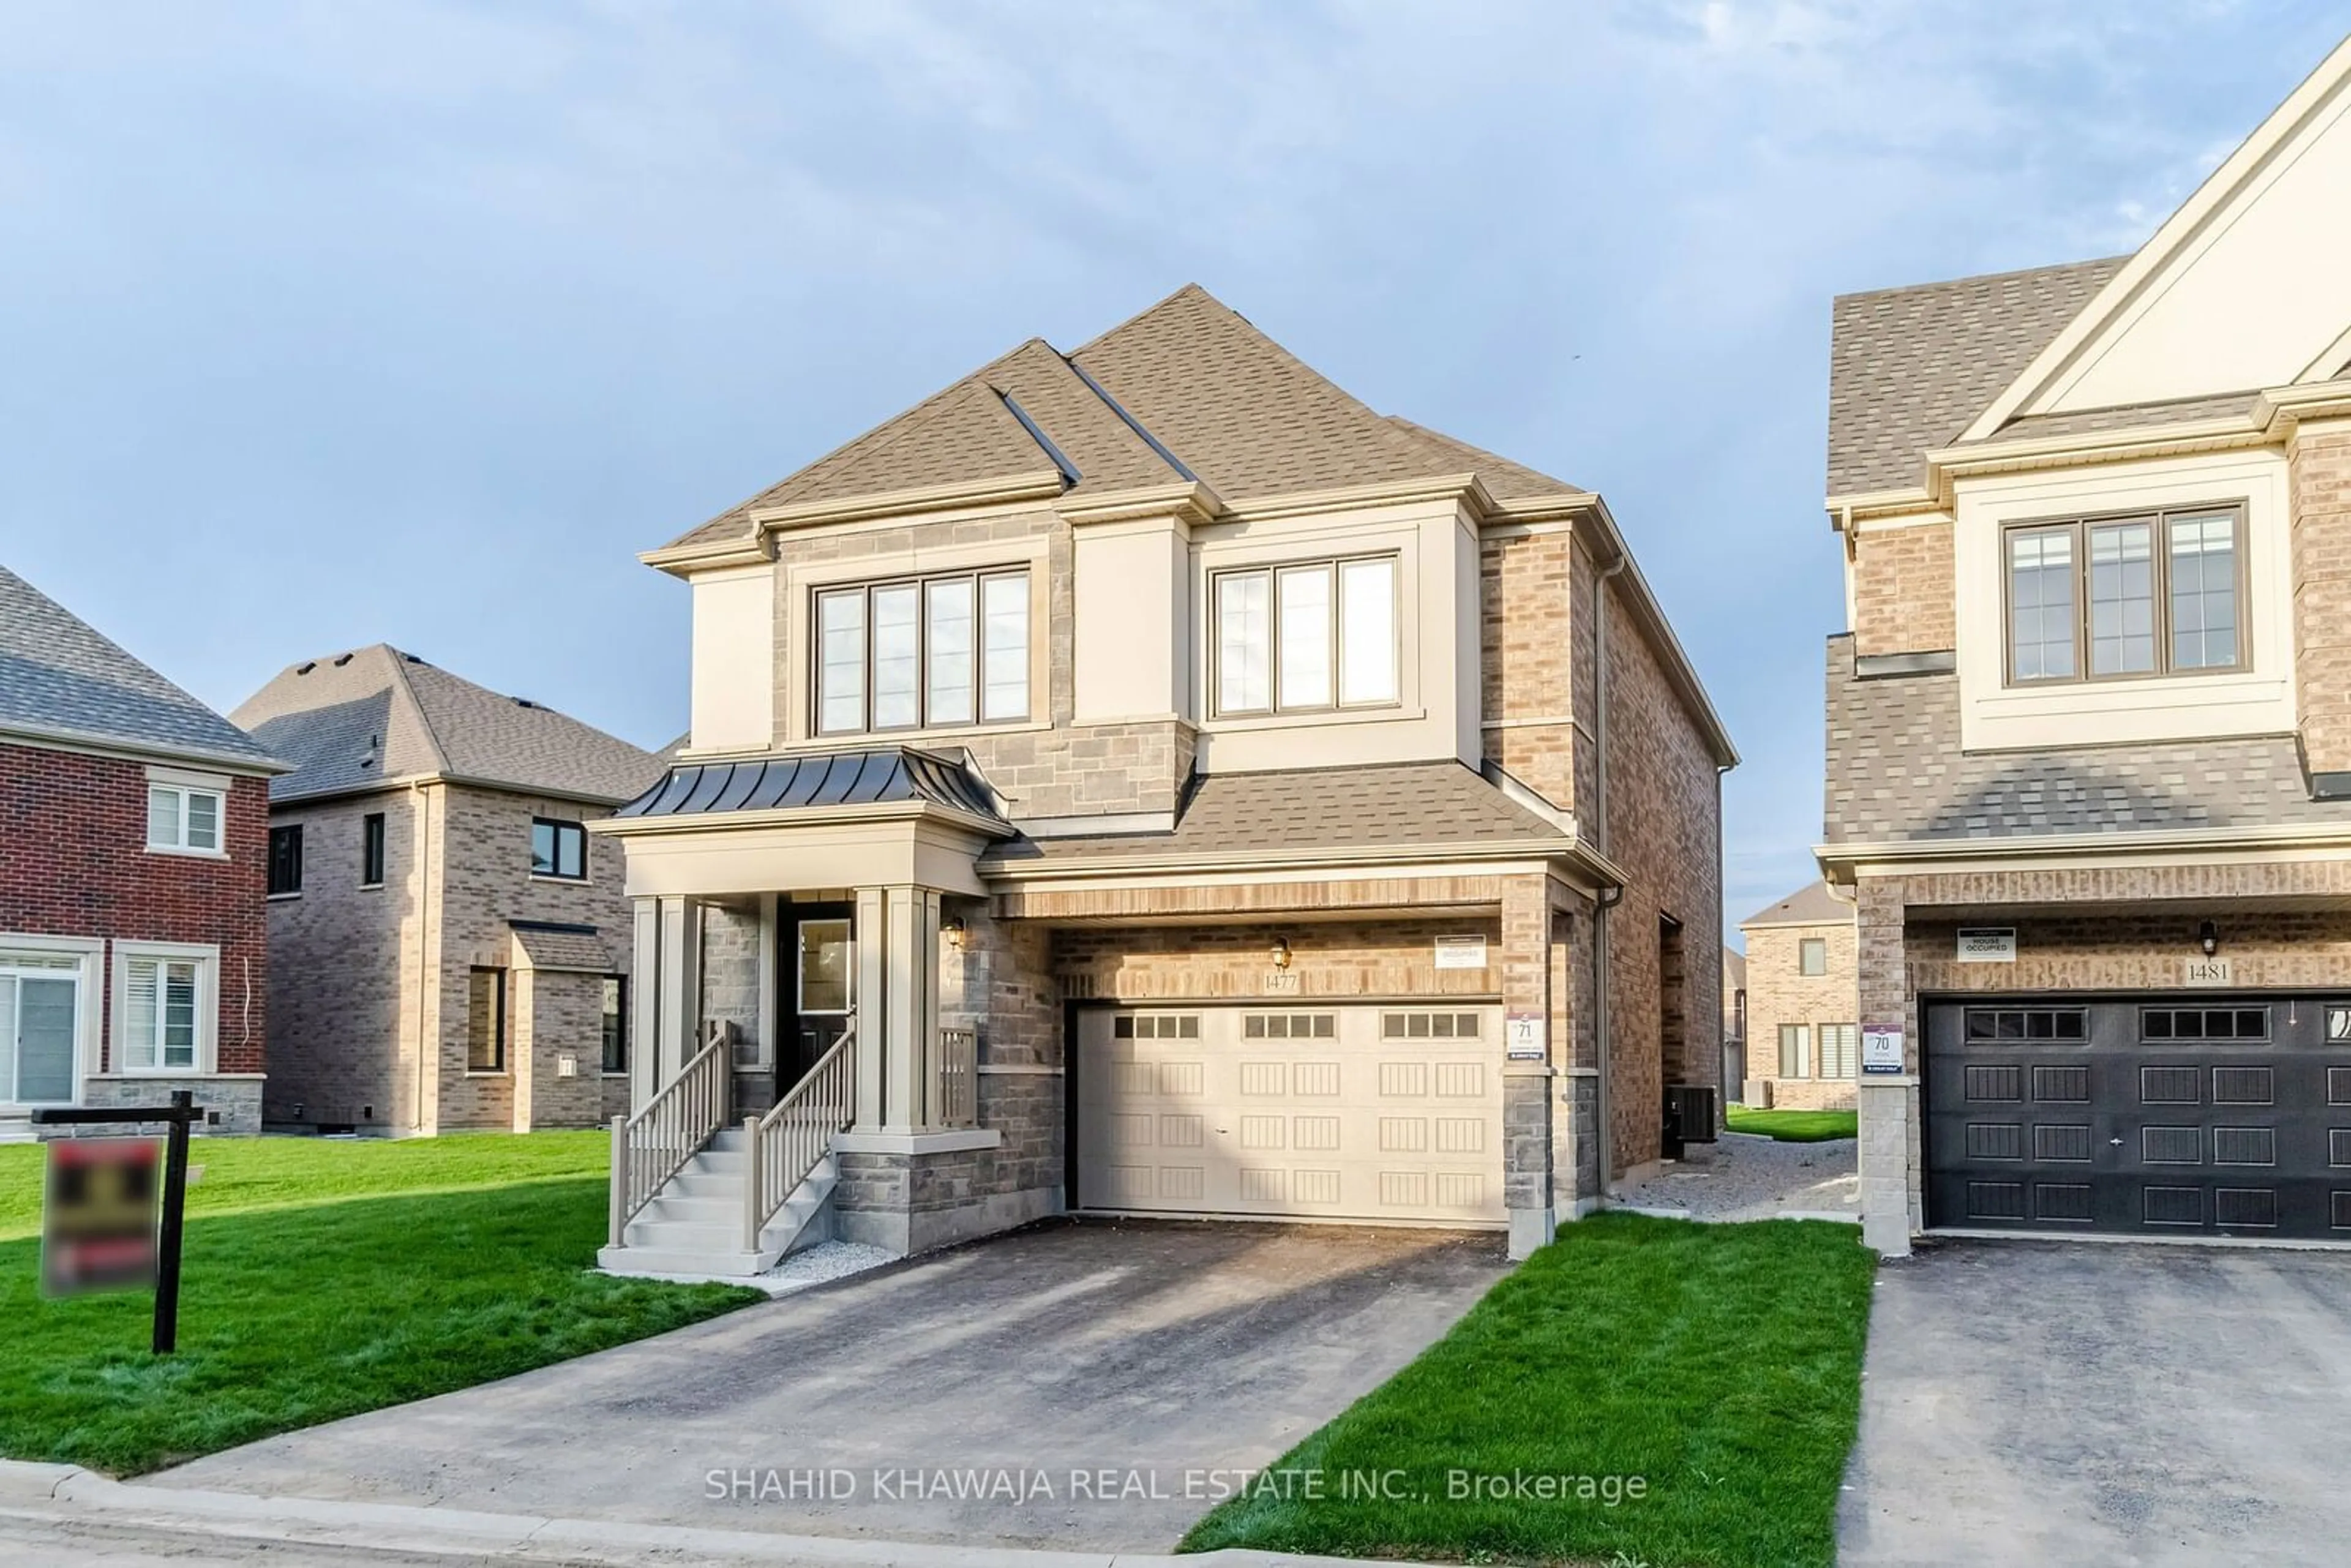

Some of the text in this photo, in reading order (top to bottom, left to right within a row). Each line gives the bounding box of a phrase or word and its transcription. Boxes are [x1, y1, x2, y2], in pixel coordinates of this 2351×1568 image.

[2191, 964, 2226, 980] 1481
[1266, 974, 1297, 989] 1477
[1519, 1024, 1531, 1037] 71
[1875, 1037, 1889, 1050] 70
